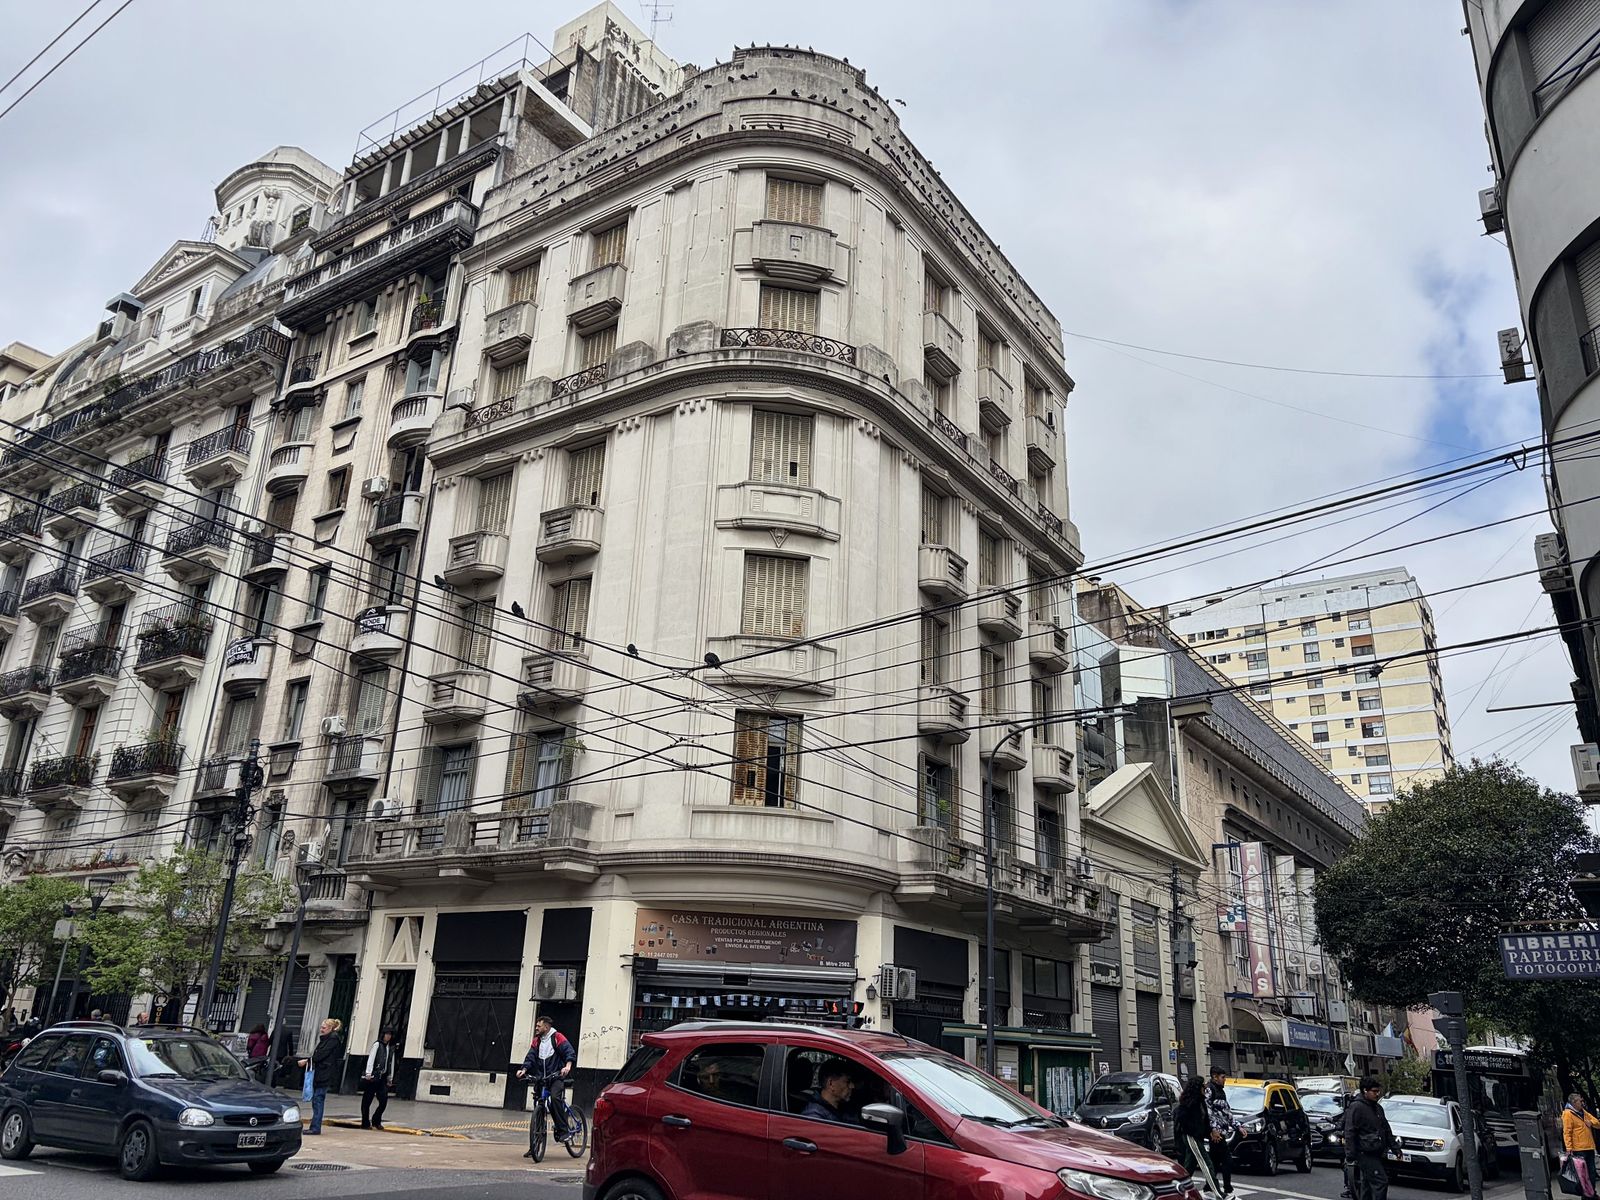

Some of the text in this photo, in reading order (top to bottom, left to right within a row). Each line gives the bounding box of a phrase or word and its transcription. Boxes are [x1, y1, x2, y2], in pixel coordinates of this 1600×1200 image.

[671, 914, 825, 931] CASA TRADICIONAL ARGENTINA
[1246, 848, 1269, 991] FARMACIAS
[747, 930, 787, 938] REGIONALES
[1503, 935, 1597, 950] LIBRERI
[1515, 962, 1600, 975] FOTOCOPIA
